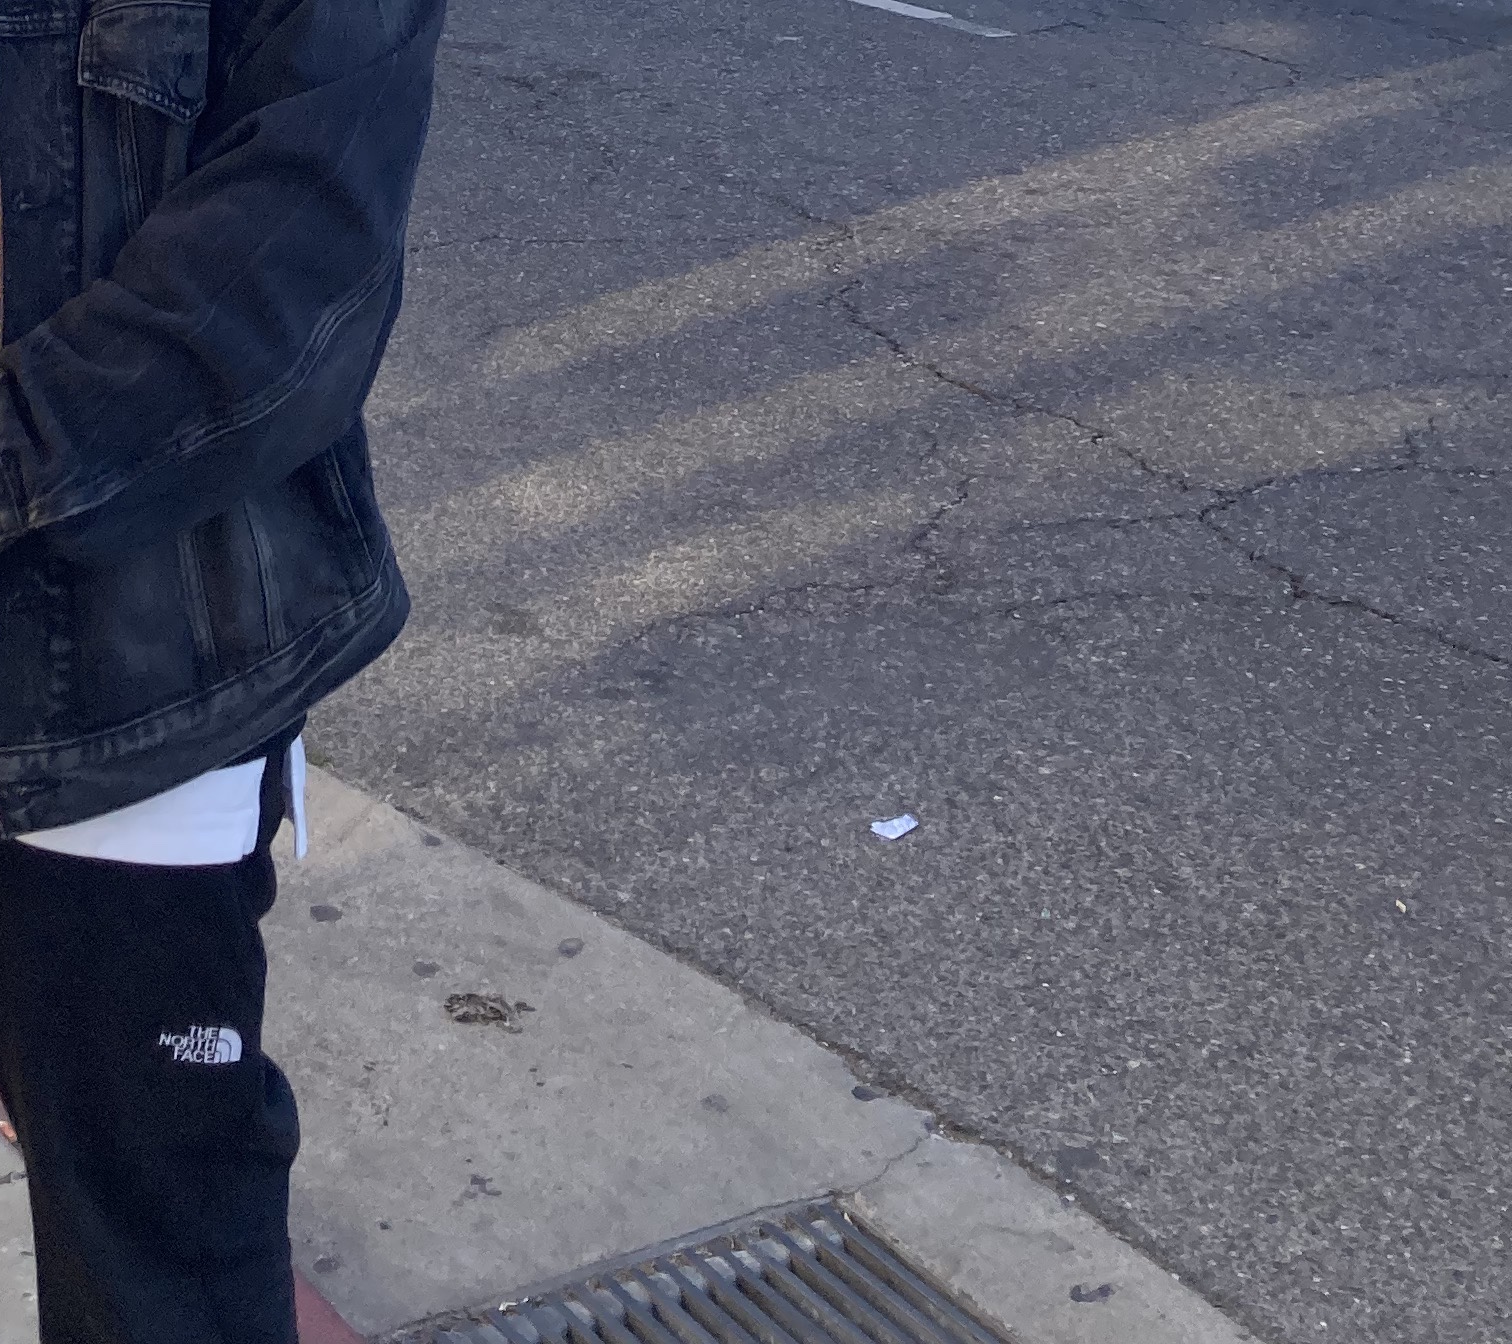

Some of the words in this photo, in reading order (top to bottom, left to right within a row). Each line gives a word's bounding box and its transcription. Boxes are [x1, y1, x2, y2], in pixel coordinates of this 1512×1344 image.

[188, 1025, 219, 1040] THE
[158, 1032, 217, 1052] NORTH
[173, 1046, 215, 1063] FACE
